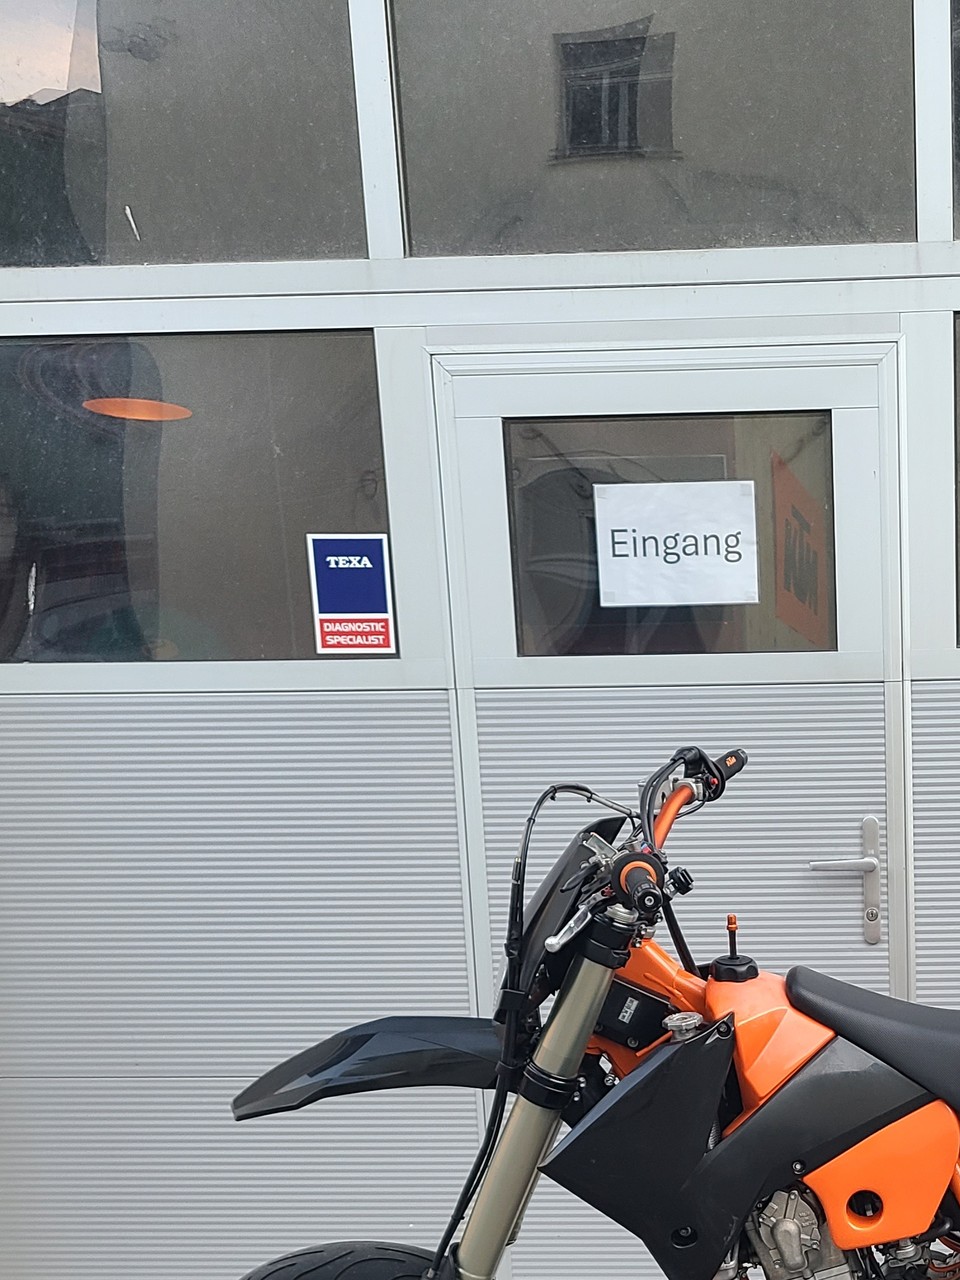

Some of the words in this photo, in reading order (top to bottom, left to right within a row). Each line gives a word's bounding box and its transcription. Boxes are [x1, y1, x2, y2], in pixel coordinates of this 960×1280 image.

[611, 528, 743, 565] Eingang
[325, 556, 373, 568] TEXA
[323, 622, 386, 632] DIAGNOSTIC
[325, 635, 386, 645] SPECIALIST
